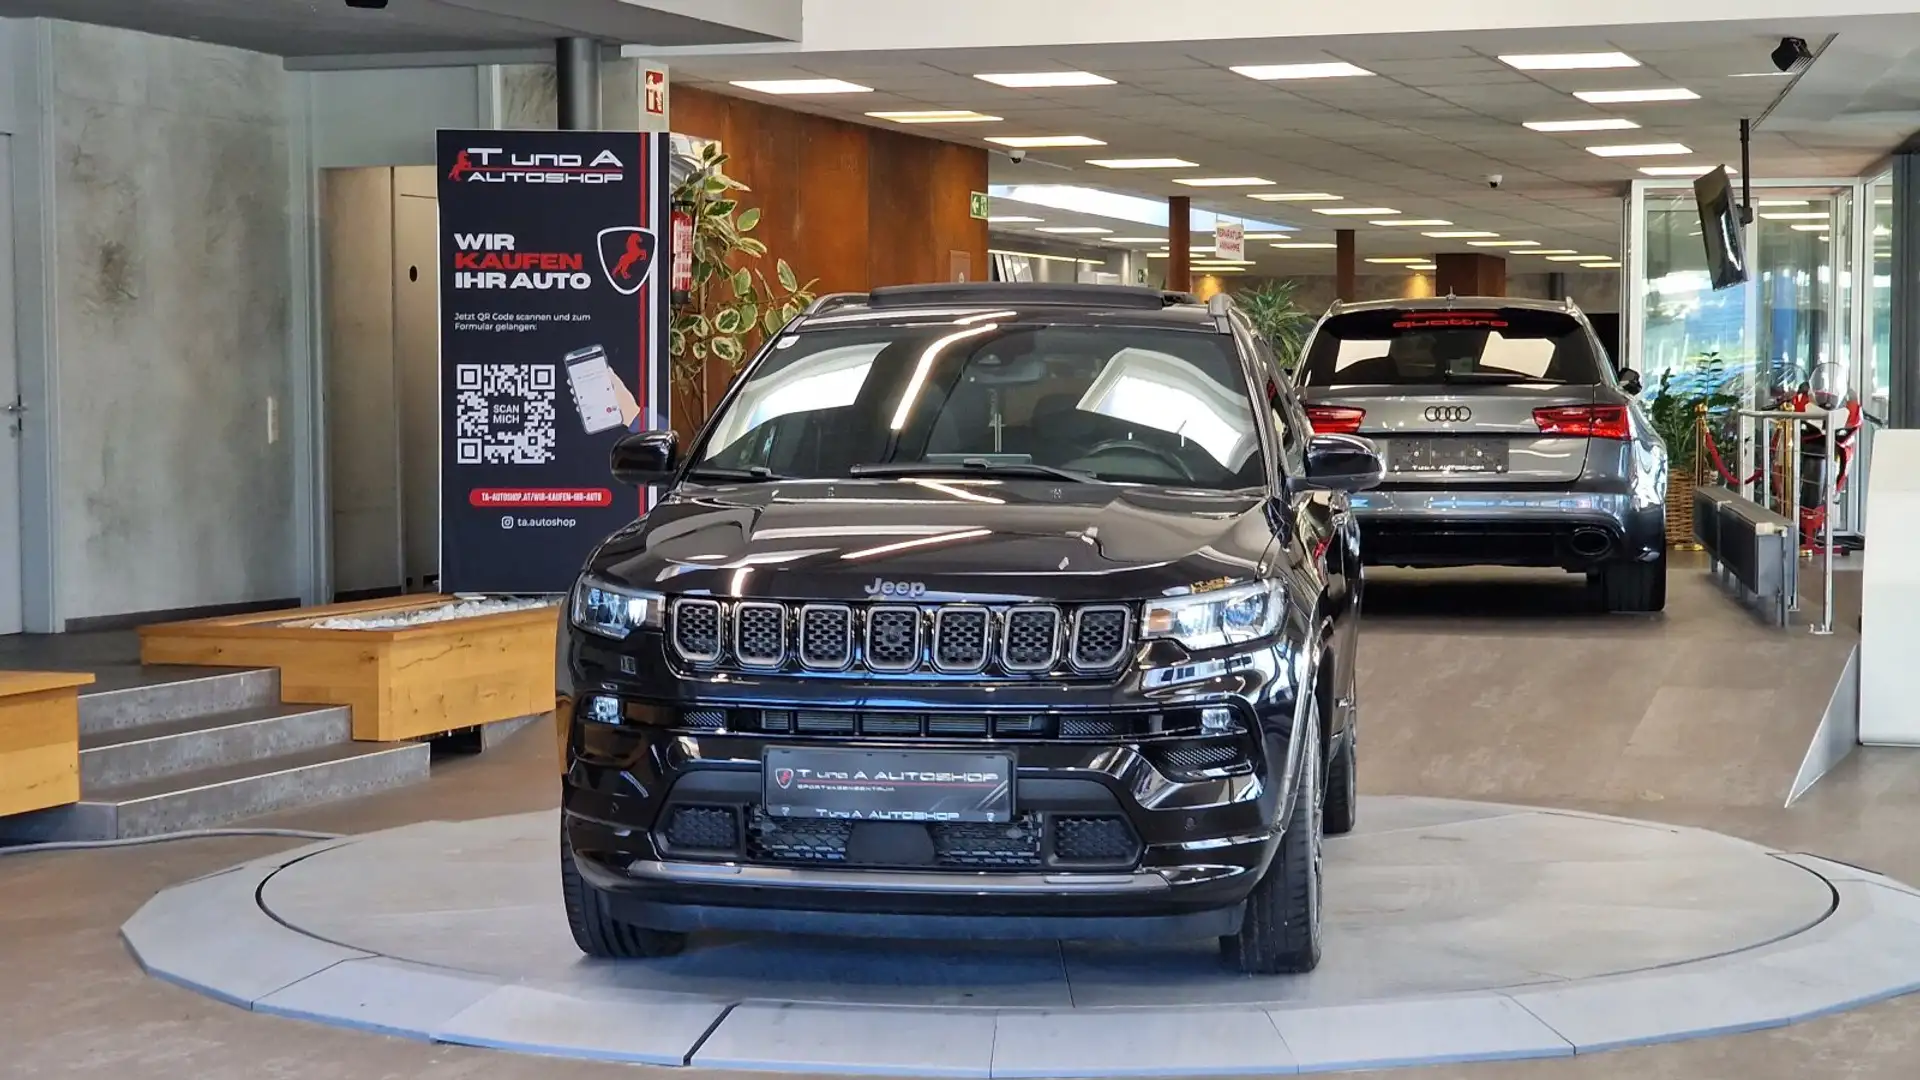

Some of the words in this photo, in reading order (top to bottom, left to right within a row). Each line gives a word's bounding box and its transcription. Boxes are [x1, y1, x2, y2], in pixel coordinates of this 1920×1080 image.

[467, 147, 503, 166] T
[589, 149, 624, 167] A
[467, 171, 624, 184] AUTOSHOP
[454, 233, 515, 251] WIR
[455, 253, 583, 270] KAUFEN
[454, 272, 507, 289] IHR
[510, 272, 592, 290] AUTO
[454, 312, 476, 322] Jetzt
[477, 313, 491, 322] QR
[492, 313, 515, 322] Code
[516, 314, 552, 322] scannen
[553, 313, 571, 322] und
[572, 314, 591, 322] zum
[1392, 318, 1509, 328] quattro
[454, 322, 494, 332] Formular
[493, 404, 520, 414] SCAN
[492, 414, 520, 424] MICH
[517, 517, 577, 529] ta.autoshop
[864, 577, 927, 598] Jeep
[796, 769, 812, 778] T
[853, 770, 868, 781] A
[874, 771, 999, 783] AUTOSHOP
[815, 808, 828, 818] T
[848, 810, 863, 820] A
[868, 810, 960, 821] AUTOSHOP
